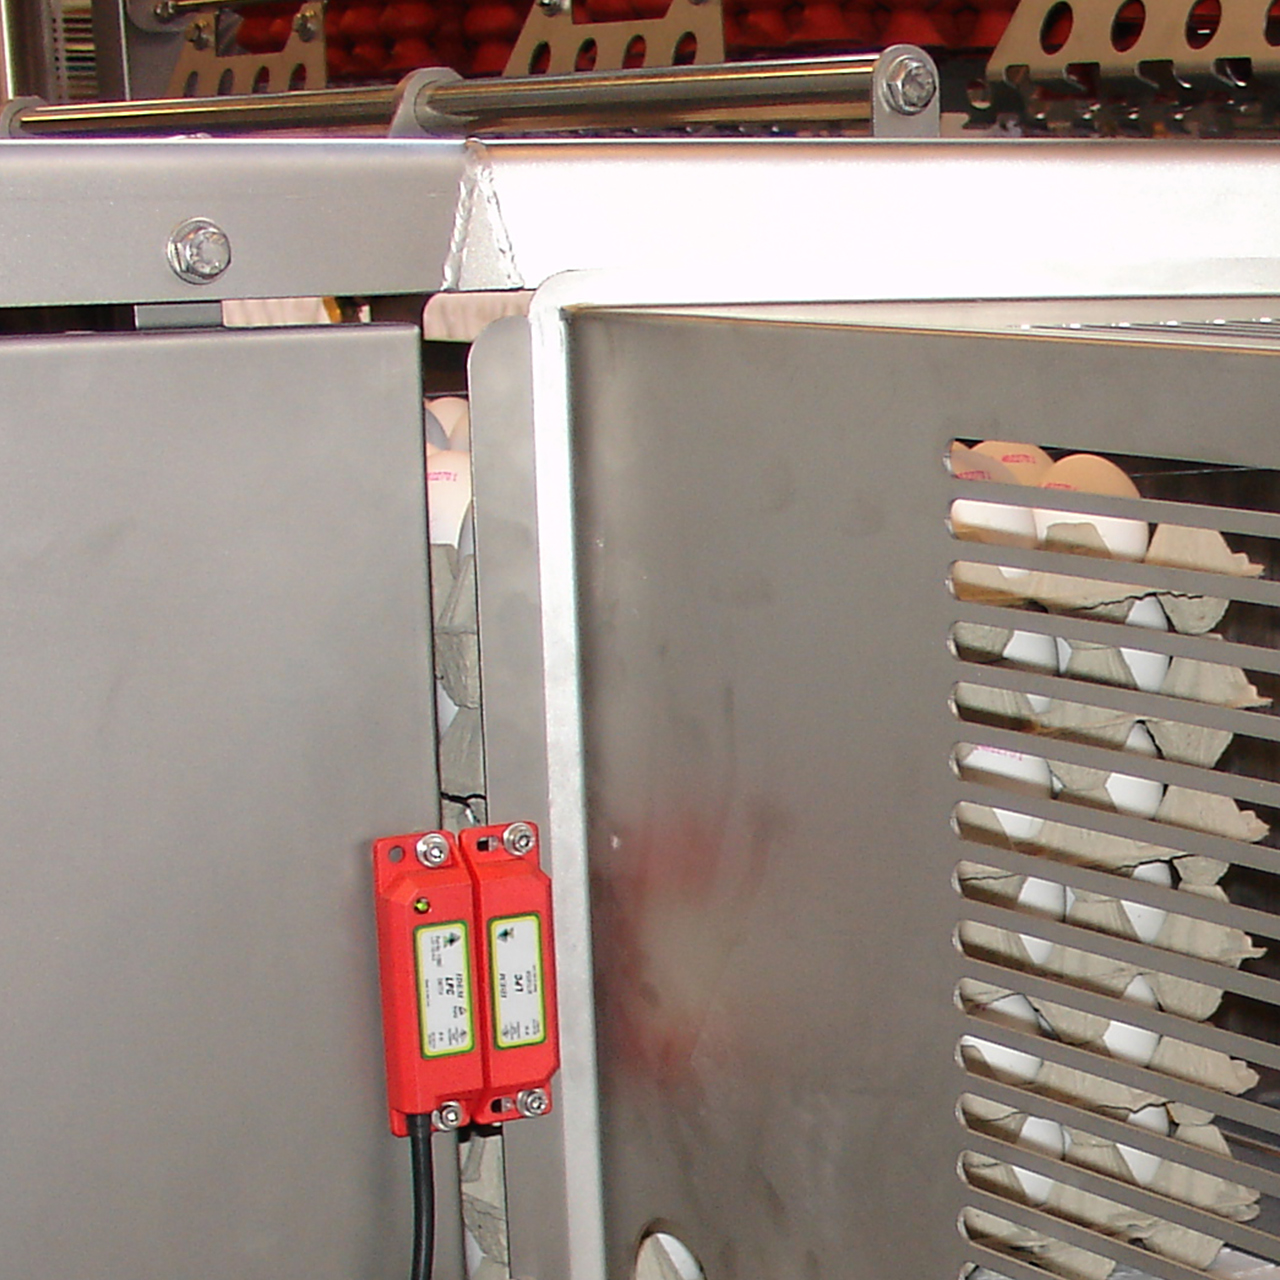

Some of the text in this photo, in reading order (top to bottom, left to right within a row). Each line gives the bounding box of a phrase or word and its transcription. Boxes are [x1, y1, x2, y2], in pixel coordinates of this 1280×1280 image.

[445, 977, 455, 996] LPC
[456, 973, 464, 998] IDEM
[499, 973, 507, 998] IDEM
[514, 973, 524, 992] LPC
